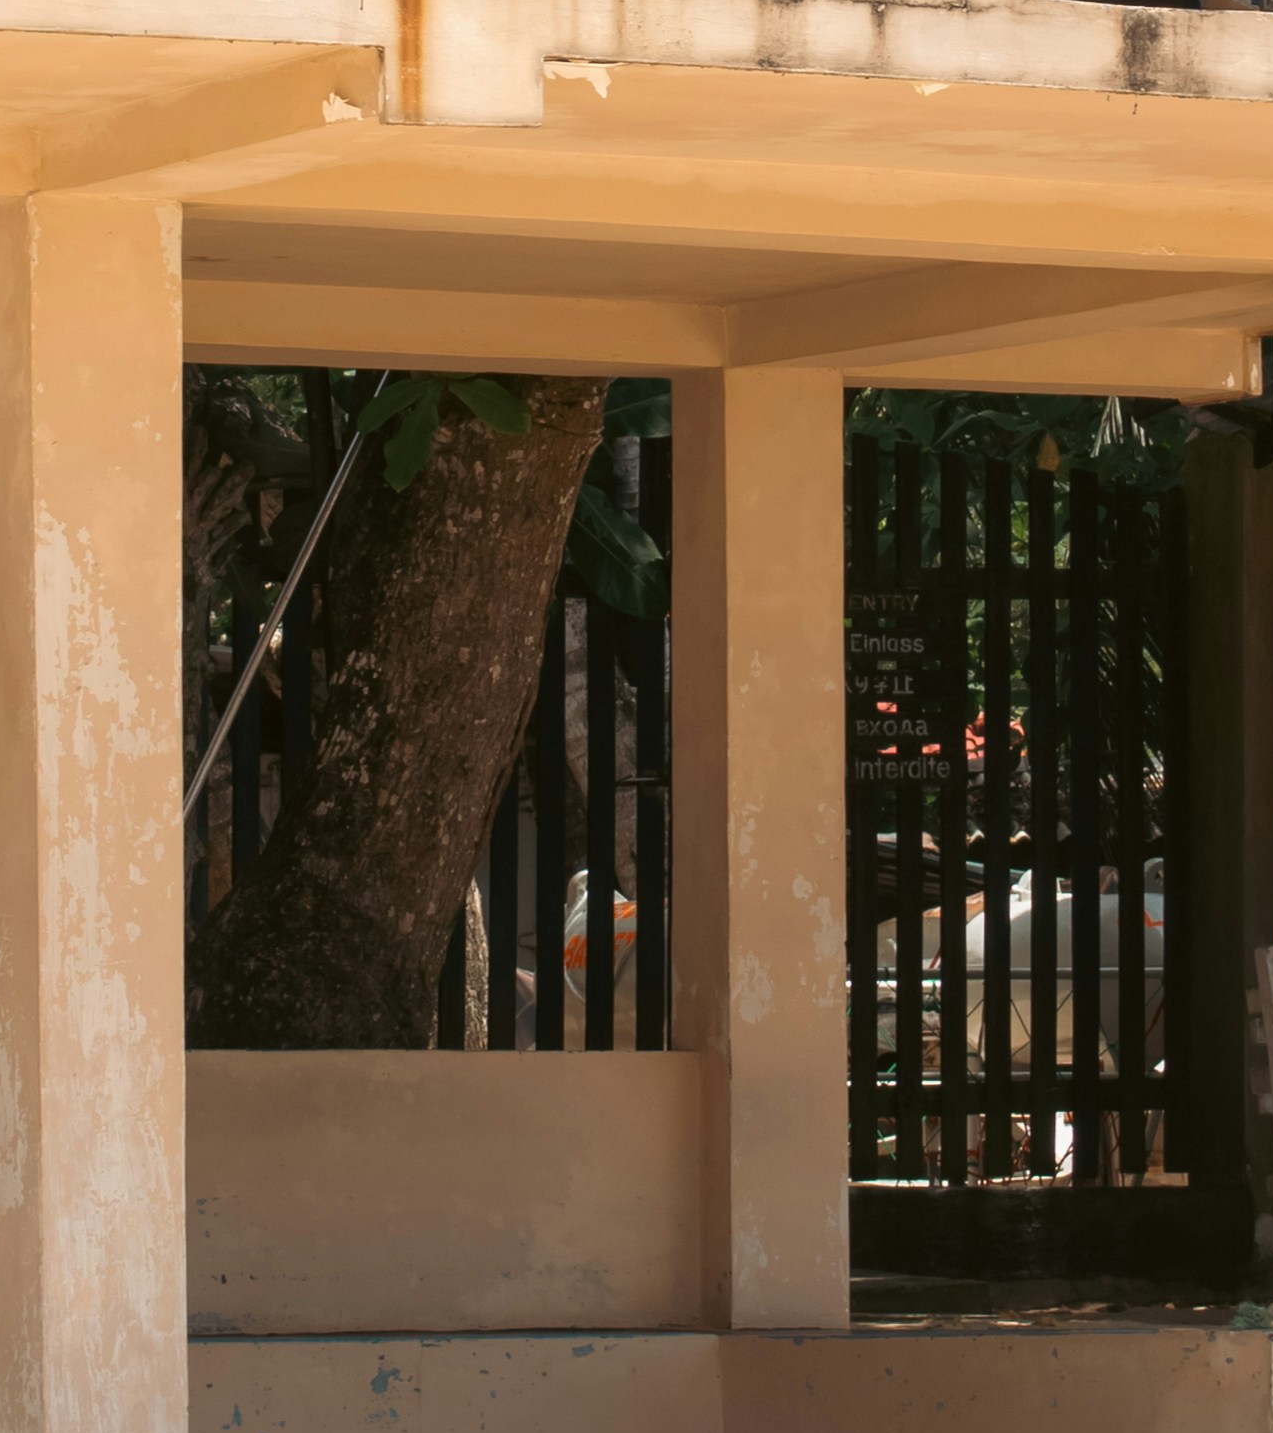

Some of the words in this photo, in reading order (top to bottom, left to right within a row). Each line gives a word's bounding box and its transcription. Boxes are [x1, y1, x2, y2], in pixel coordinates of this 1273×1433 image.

[848, 594, 920, 611] ENTRY
[850, 633, 925, 653] Einlass
[854, 756, 951, 780] Interdite
